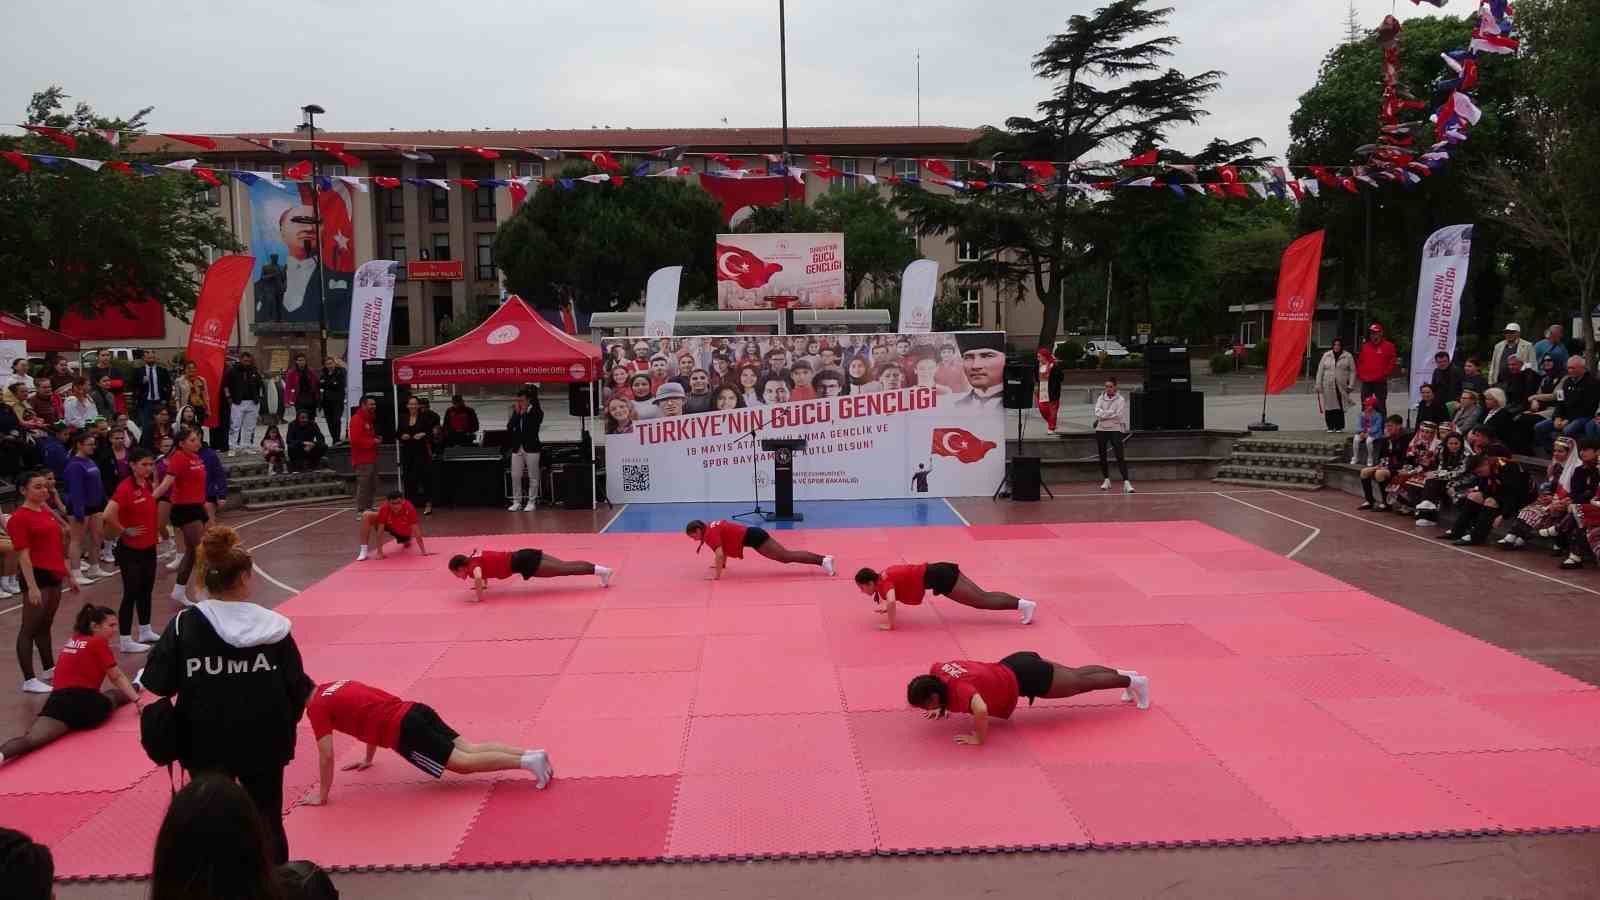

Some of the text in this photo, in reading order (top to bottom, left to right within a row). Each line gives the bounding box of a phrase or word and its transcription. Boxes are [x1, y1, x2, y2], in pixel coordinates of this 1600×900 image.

[496, 367, 515, 375] SPOR
[635, 409, 763, 446] TÜRKİYE'NİN
[838, 386, 937, 419] GENÇLİĞİ
[701, 443, 733, 454] MAYIS
[876, 424, 889, 433] VE
[703, 457, 729, 468] SPOR
[802, 445, 833, 457] KUTLU
[838, 440, 873, 452] OLSUN!
[186, 653, 277, 678] PUMA.
